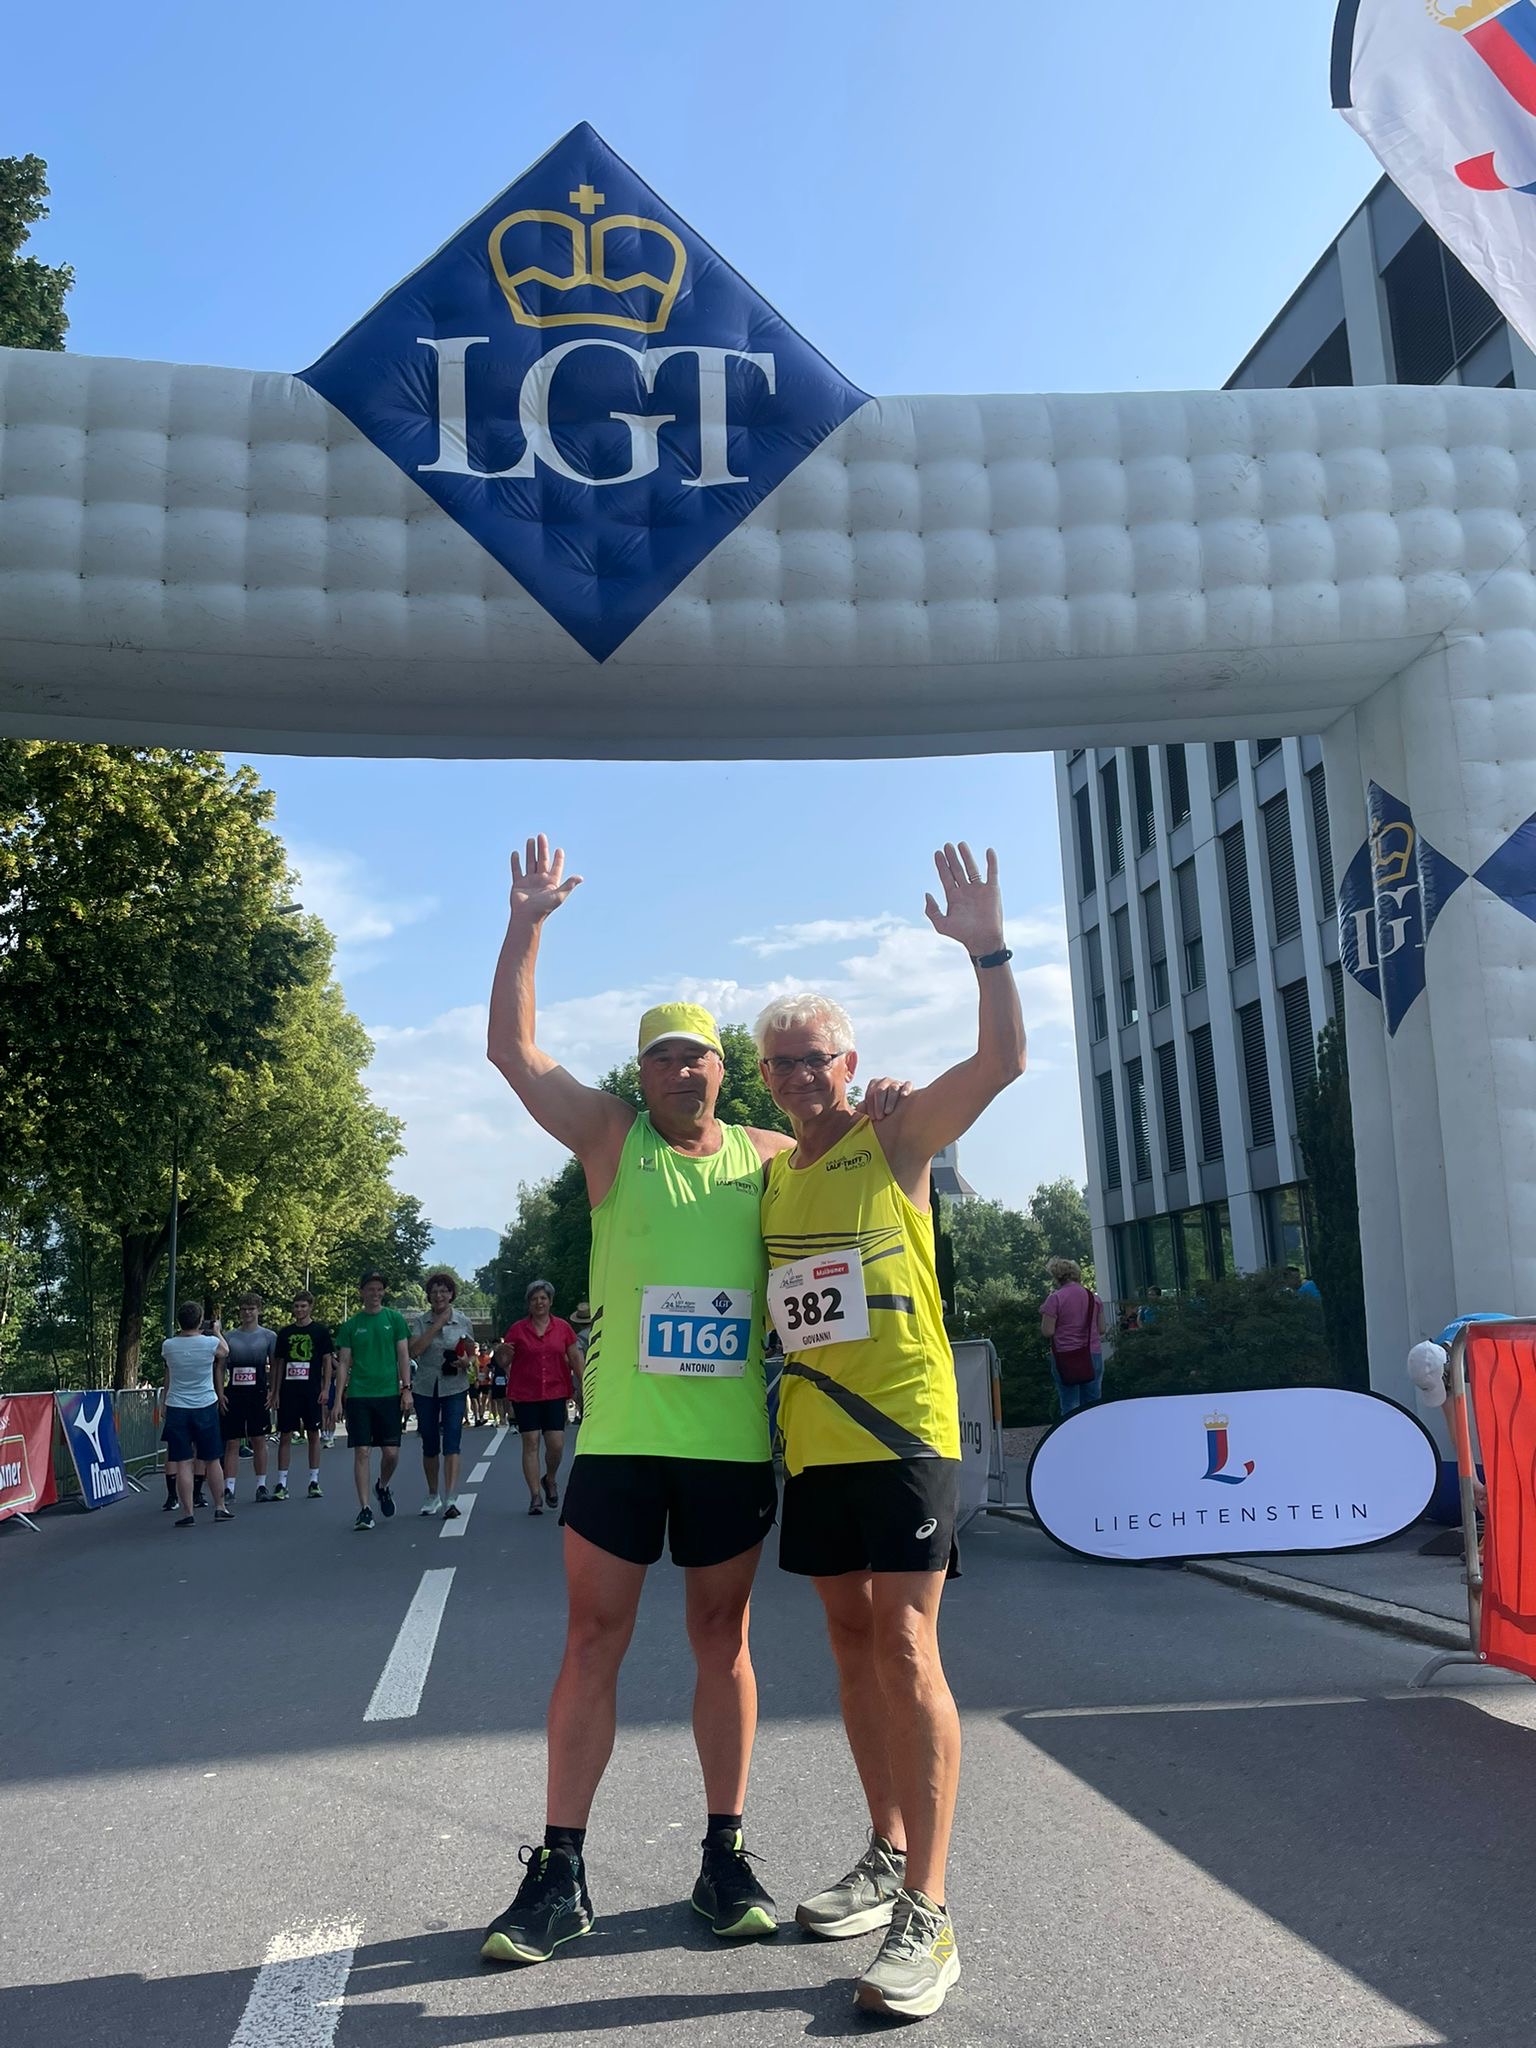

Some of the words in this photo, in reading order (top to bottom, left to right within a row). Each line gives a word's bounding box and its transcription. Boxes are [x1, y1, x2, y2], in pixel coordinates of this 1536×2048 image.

[416, 335, 776, 487] LGT
[1349, 883, 1426, 974] LG
[715, 1299, 730, 1308] LGT
[783, 1287, 845, 1330] 382
[657, 1321, 739, 1356] 1166
[802, 1331, 832, 1345] GIOVANNI
[679, 1362, 716, 1373] ANTONIO
[1094, 1503, 1368, 1533] LIECHTENSTEIN
